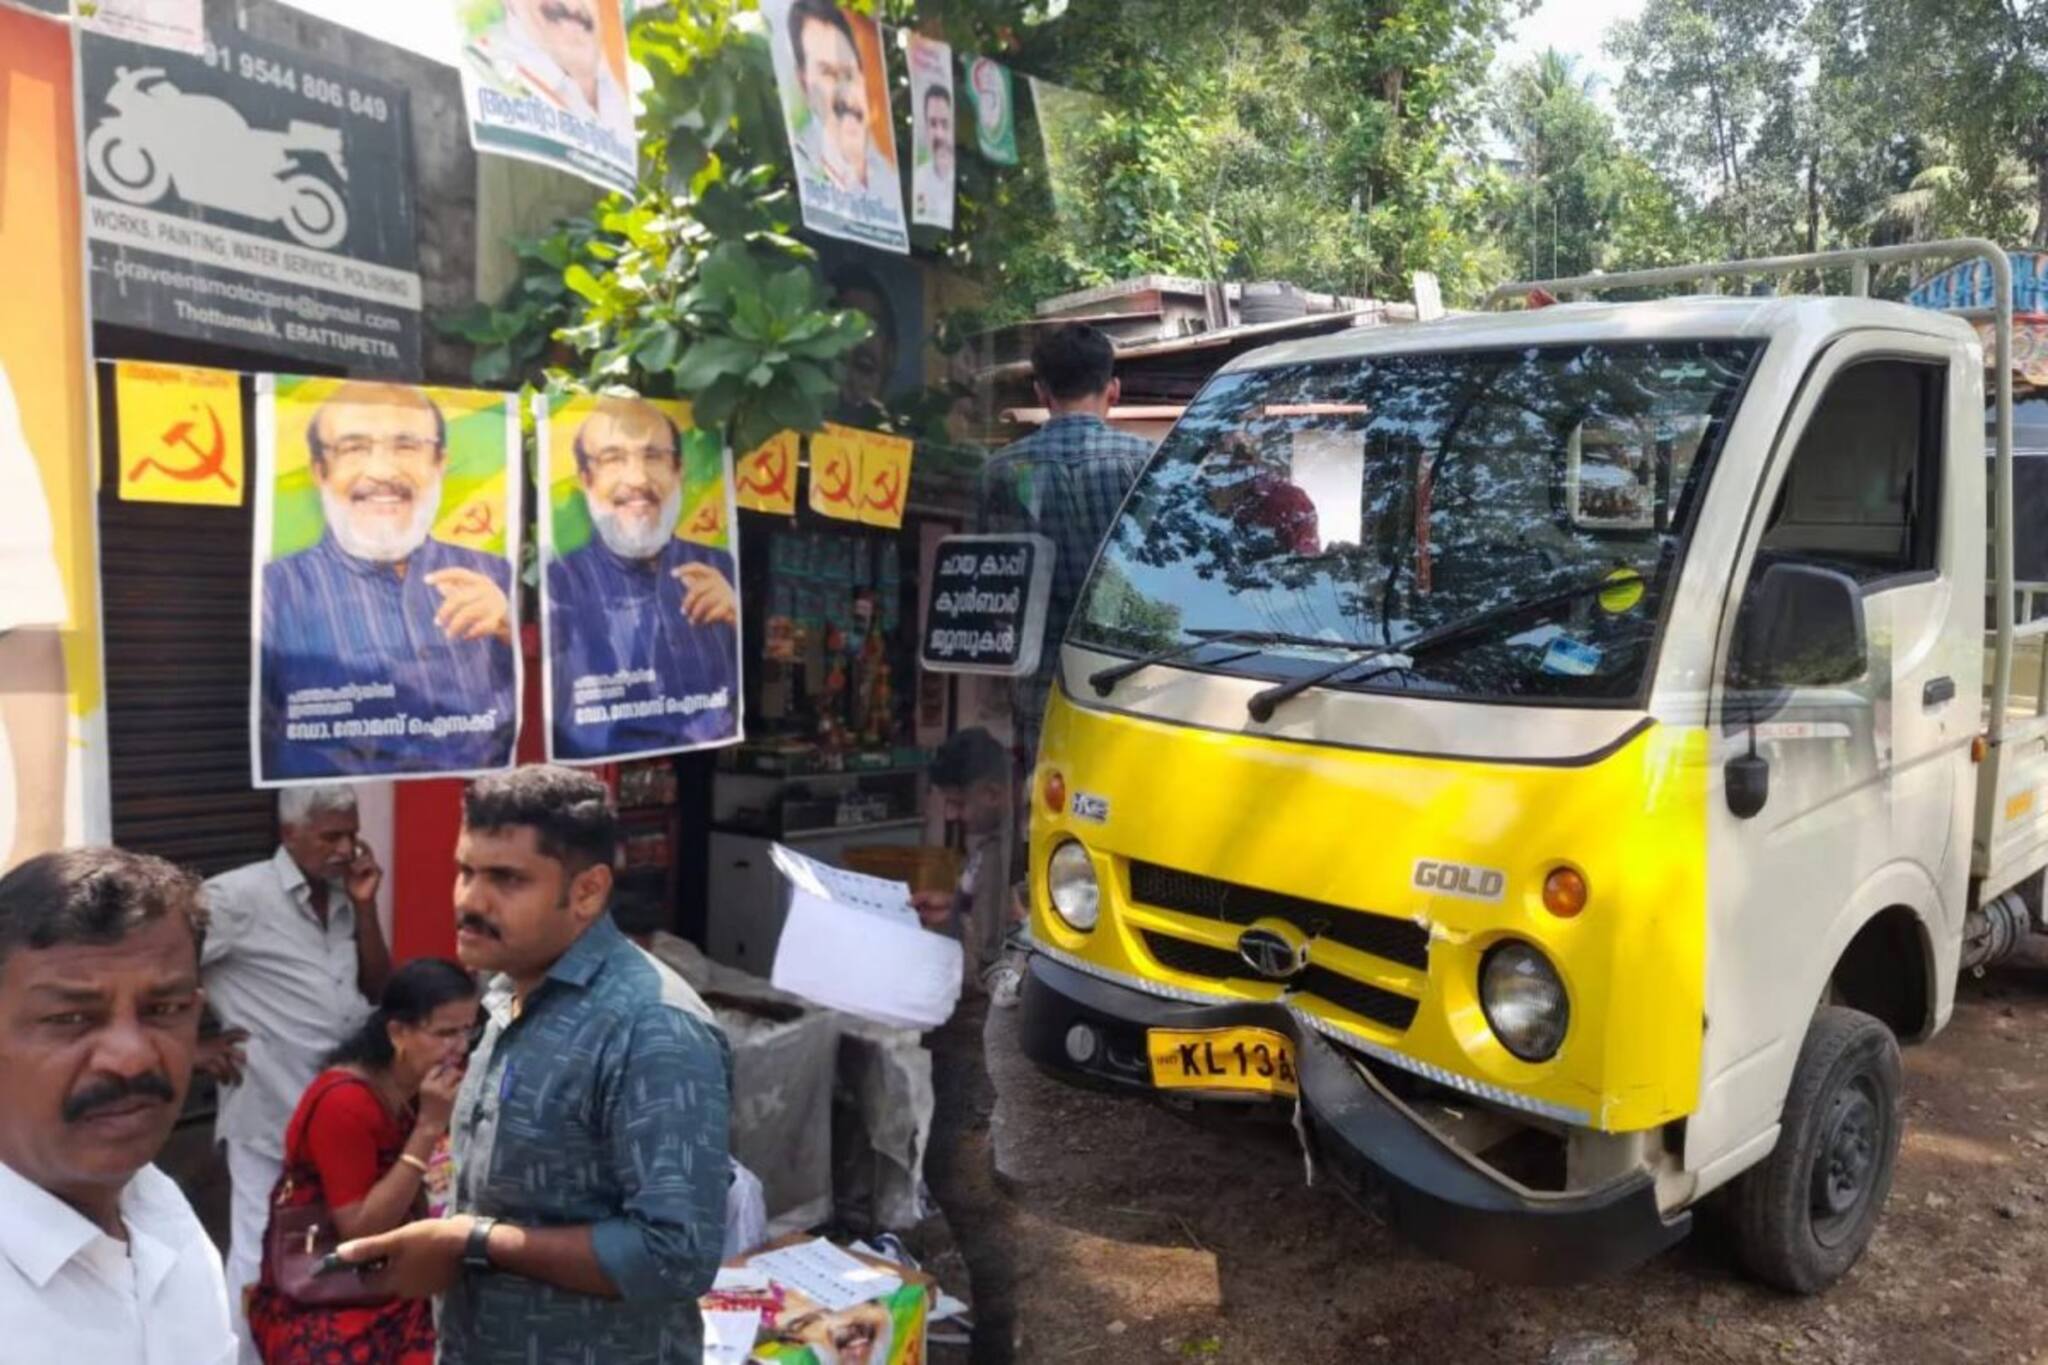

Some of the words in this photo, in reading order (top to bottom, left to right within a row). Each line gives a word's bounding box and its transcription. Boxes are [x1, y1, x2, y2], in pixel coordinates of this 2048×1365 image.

[239, 52, 297, 93] 9544
[302, 73, 344, 108] 806
[348, 88, 388, 123] 849
[285, 321, 399, 358] ERATTUPETTA
[1414, 861, 1505, 898] GOLD
